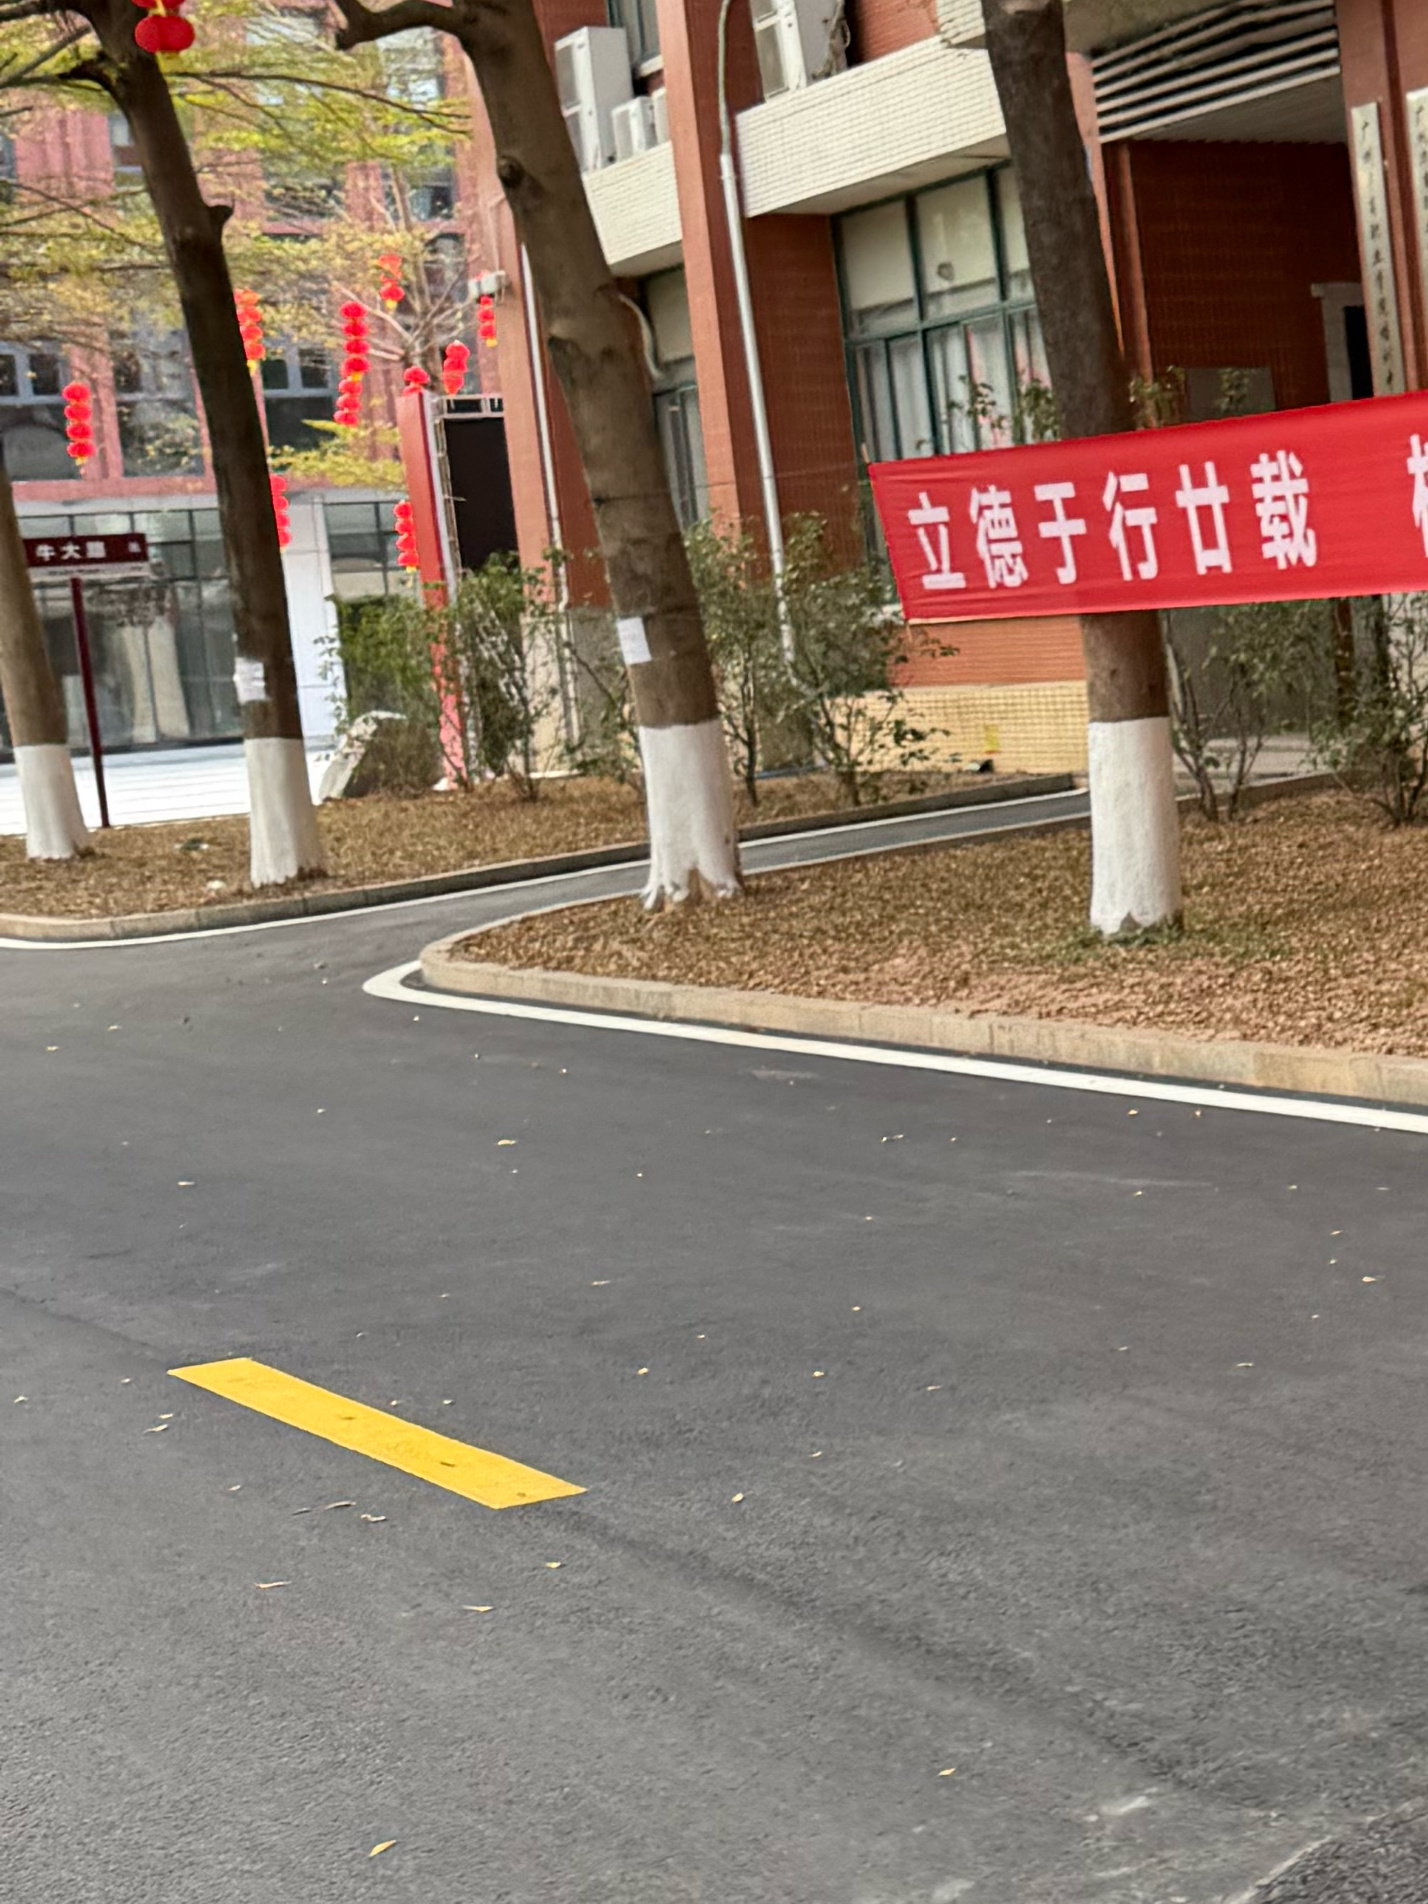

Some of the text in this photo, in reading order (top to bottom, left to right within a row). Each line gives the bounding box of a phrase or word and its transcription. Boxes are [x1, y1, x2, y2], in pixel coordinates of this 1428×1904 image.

[907, 449, 1318, 591] 立德于行廿载
